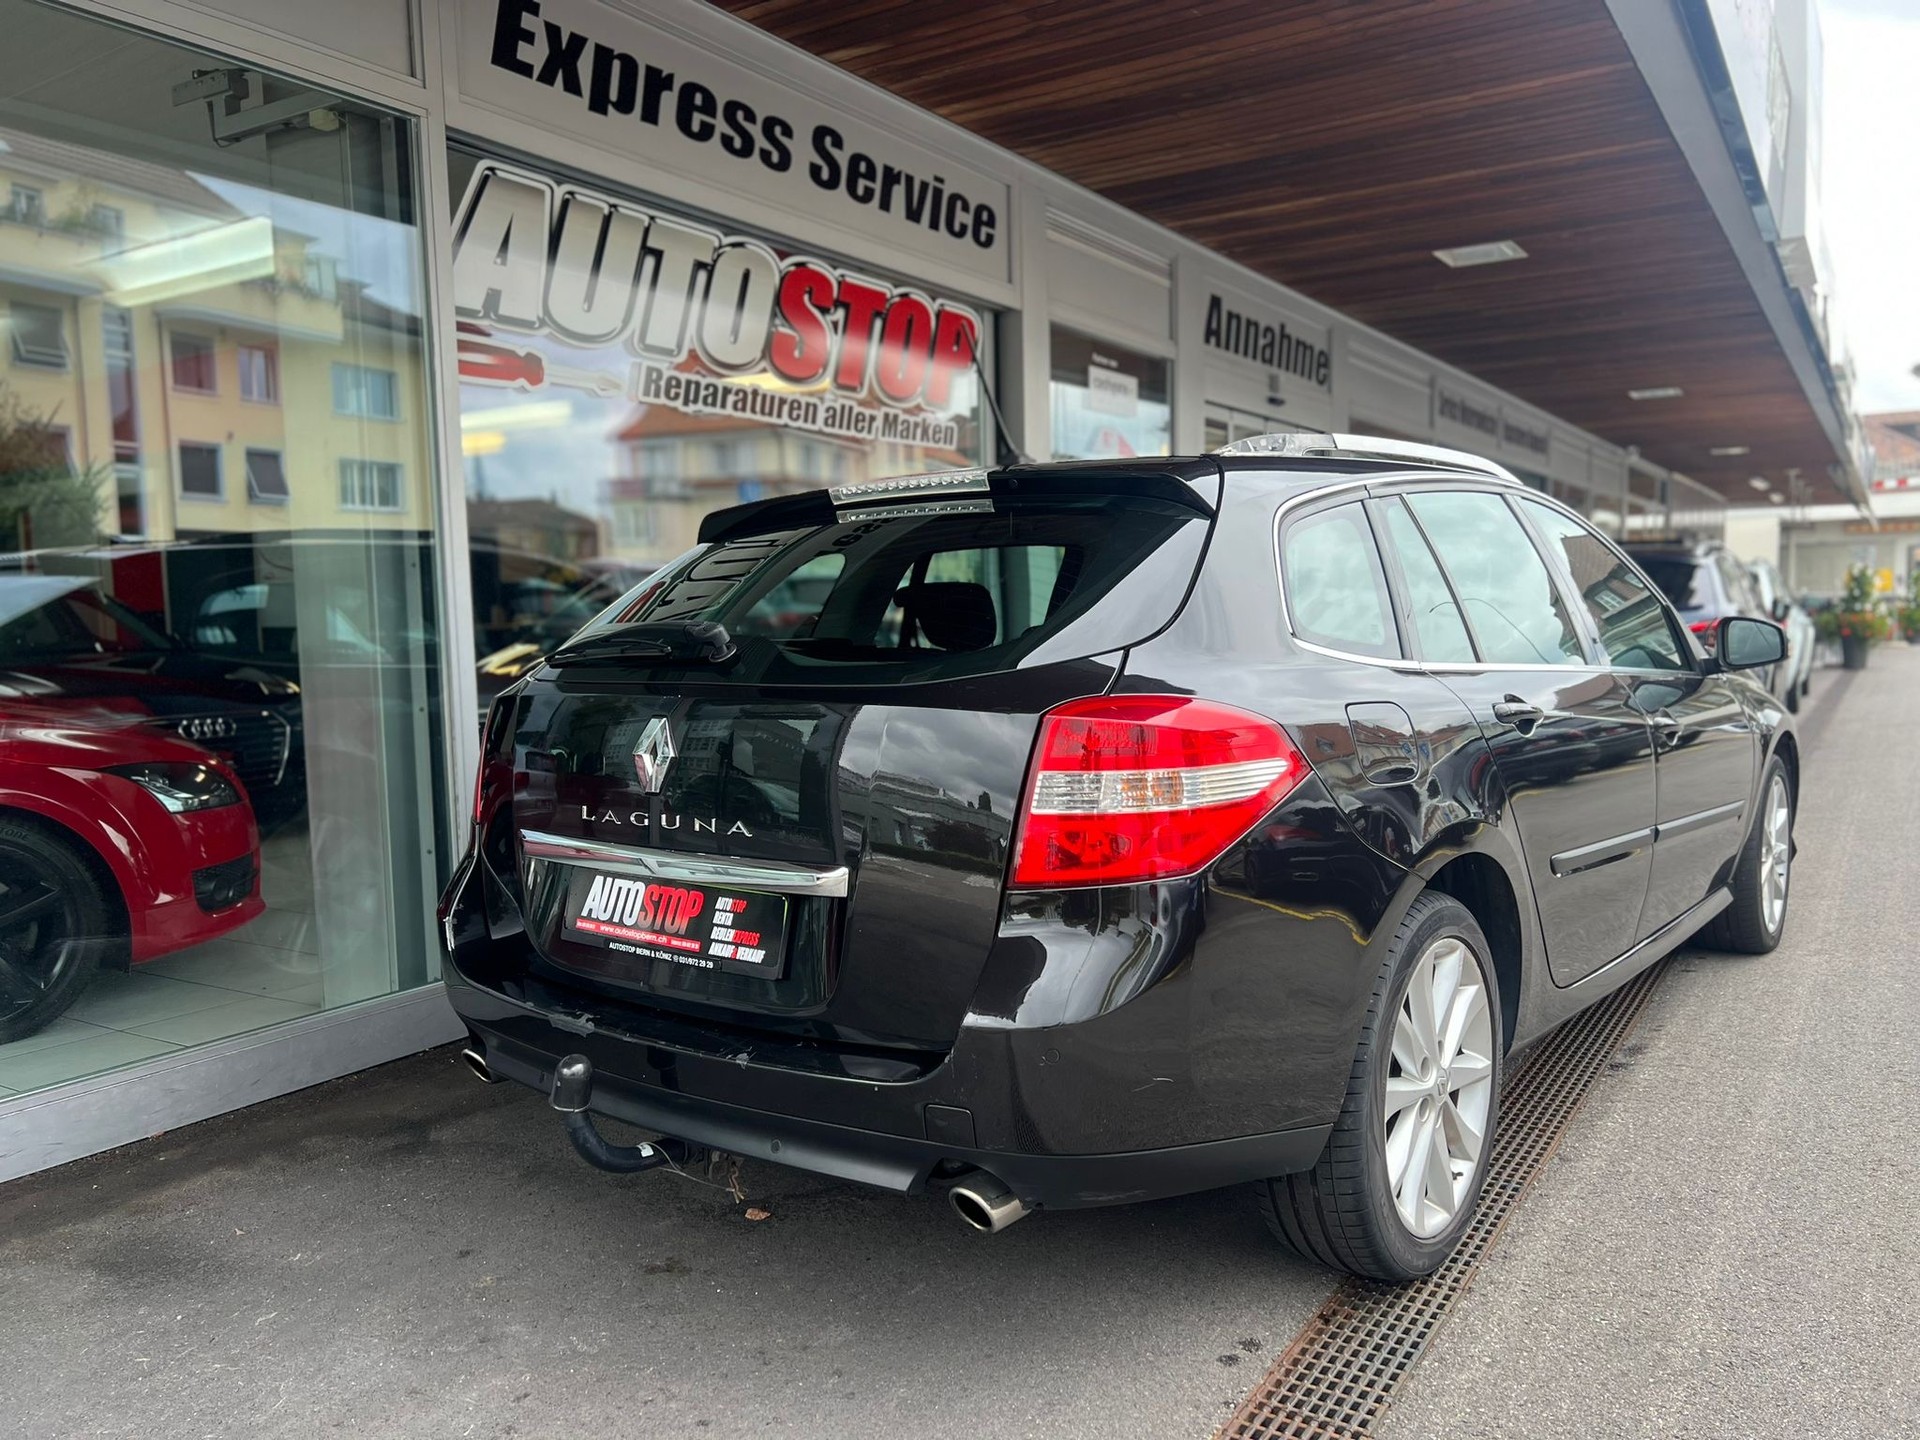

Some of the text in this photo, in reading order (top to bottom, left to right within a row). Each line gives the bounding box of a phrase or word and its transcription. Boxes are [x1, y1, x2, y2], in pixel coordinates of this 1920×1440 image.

[490, 0, 996, 249] Express Service
[451, 161, 982, 407] AUTOSTOP
[1203, 295, 1329, 387] Annahme
[642, 367, 956, 446] Reparaturen aller Marken
[580, 805, 753, 838] LAGUNA
[580, 875, 704, 935] AUTOSTOP
[600, 925, 667, 944] www.autostopbern.ch
[714, 896, 747, 913] AUTOSTOP
[608, 941, 635, 953] AUTOSTOP
